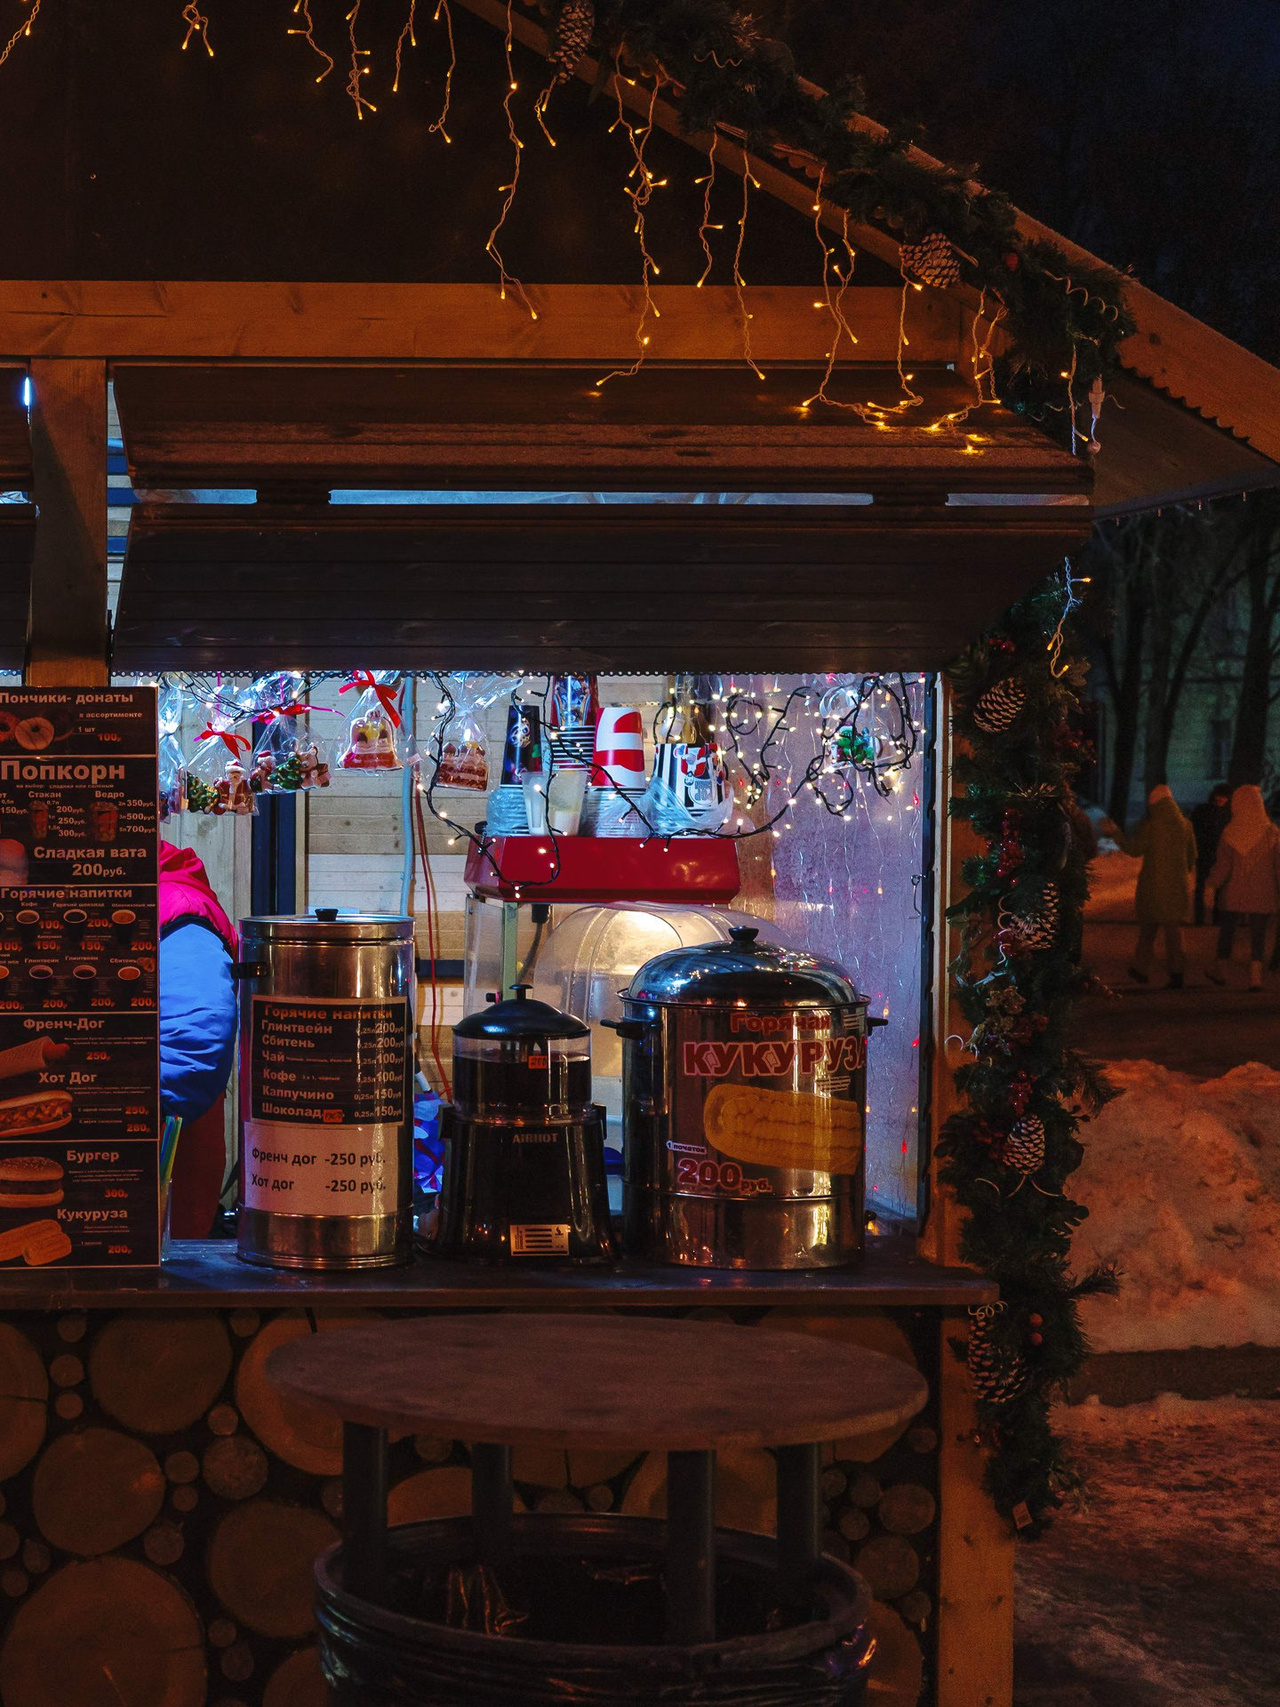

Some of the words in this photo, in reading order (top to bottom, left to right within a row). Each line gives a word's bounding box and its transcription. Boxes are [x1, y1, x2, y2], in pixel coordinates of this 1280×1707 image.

[75, 693, 133, 705] донаты
[1, 761, 125, 784] Попкорн
[95, 790, 125, 799] Ведро
[33, 846, 105, 860] Сладкая
[110, 847, 147, 858] вата
[72, 863, 126, 877] 200руб.
[0, 888, 65, 900] Горячие
[70, 889, 132, 898] напитки
[264, 1005, 326, 1020] Горячие
[332, 1009, 392, 1019] напитки
[23, 1018, 105, 1031] Френч-Дог
[261, 1020, 333, 1034] Глинтвейн
[730, 1013, 832, 1036] Горячая
[262, 1034, 315, 1048] Сбитень
[262, 1050, 285, 1063] Чай
[39, 1072, 65, 1083] Хот
[69, 1072, 97, 1084] Дог
[263, 1069, 296, 1083] Кофе
[262, 1085, 334, 1101] Каппучино
[262, 1102, 322, 1119] Шоколад
[512, 1133, 559, 1144] AIRHOT
[673, 1144, 705, 1153] початок
[66, 1151, 119, 1163] Бургер
[251, 1148, 288, 1164] Френч
[291, 1155, 317, 1166] дог
[251, 1174, 269, 1187] Хот
[271, 1181, 294, 1191] дог
[56, 1209, 128, 1222] Кукуруза
